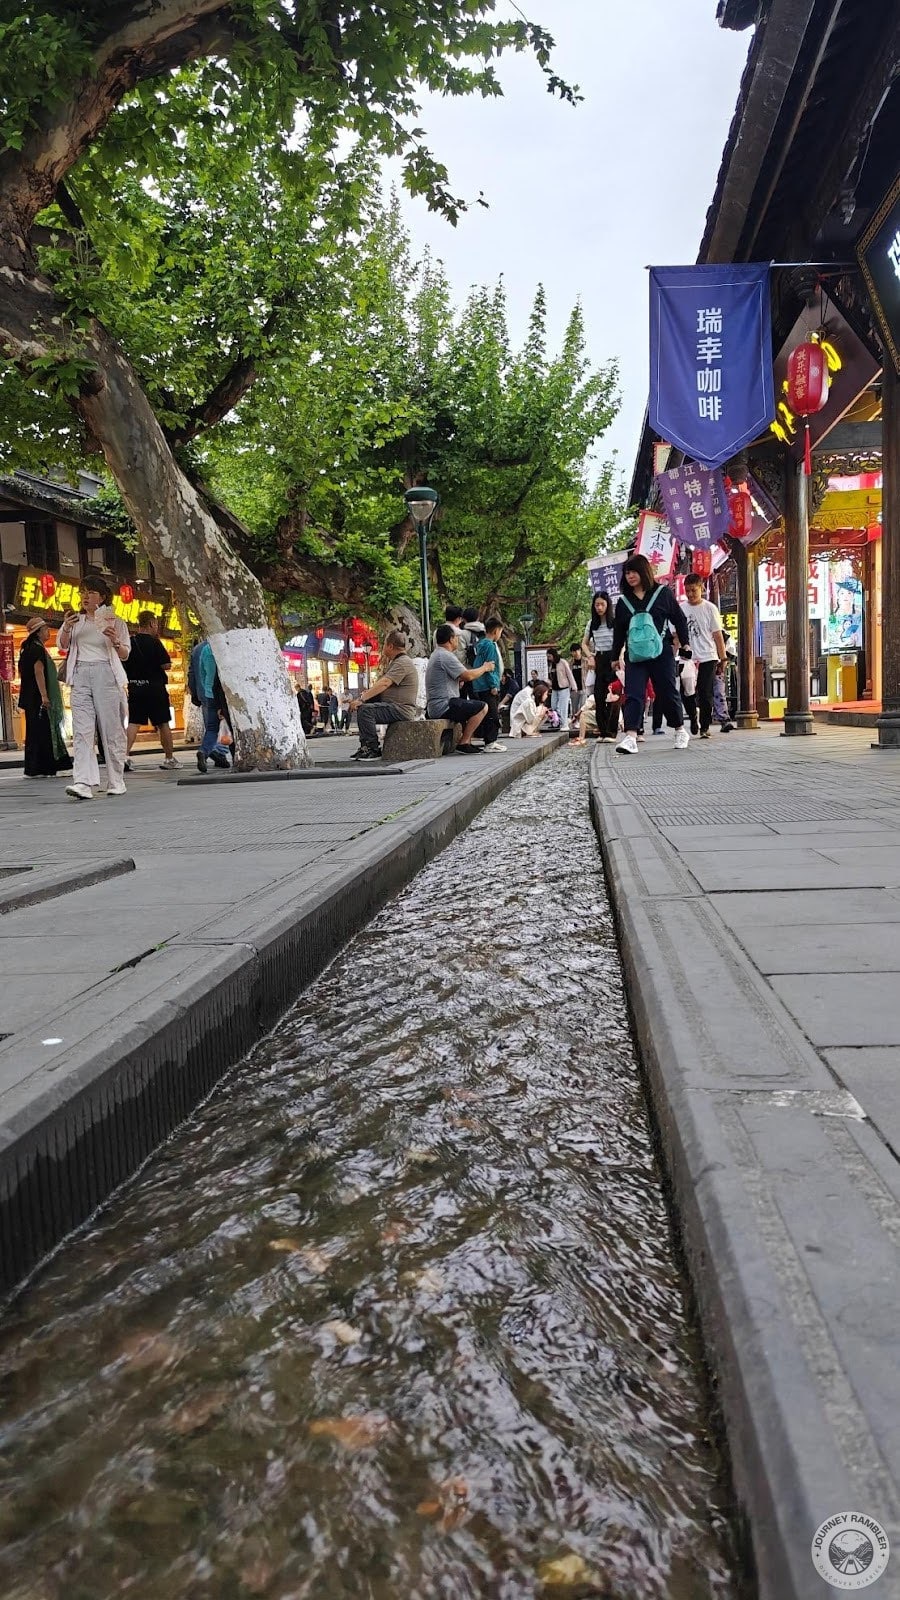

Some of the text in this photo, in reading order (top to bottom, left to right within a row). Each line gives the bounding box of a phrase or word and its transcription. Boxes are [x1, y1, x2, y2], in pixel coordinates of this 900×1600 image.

[696, 307, 723, 421] 瑞幸咖啡
[683, 478, 711, 541] 特色面
